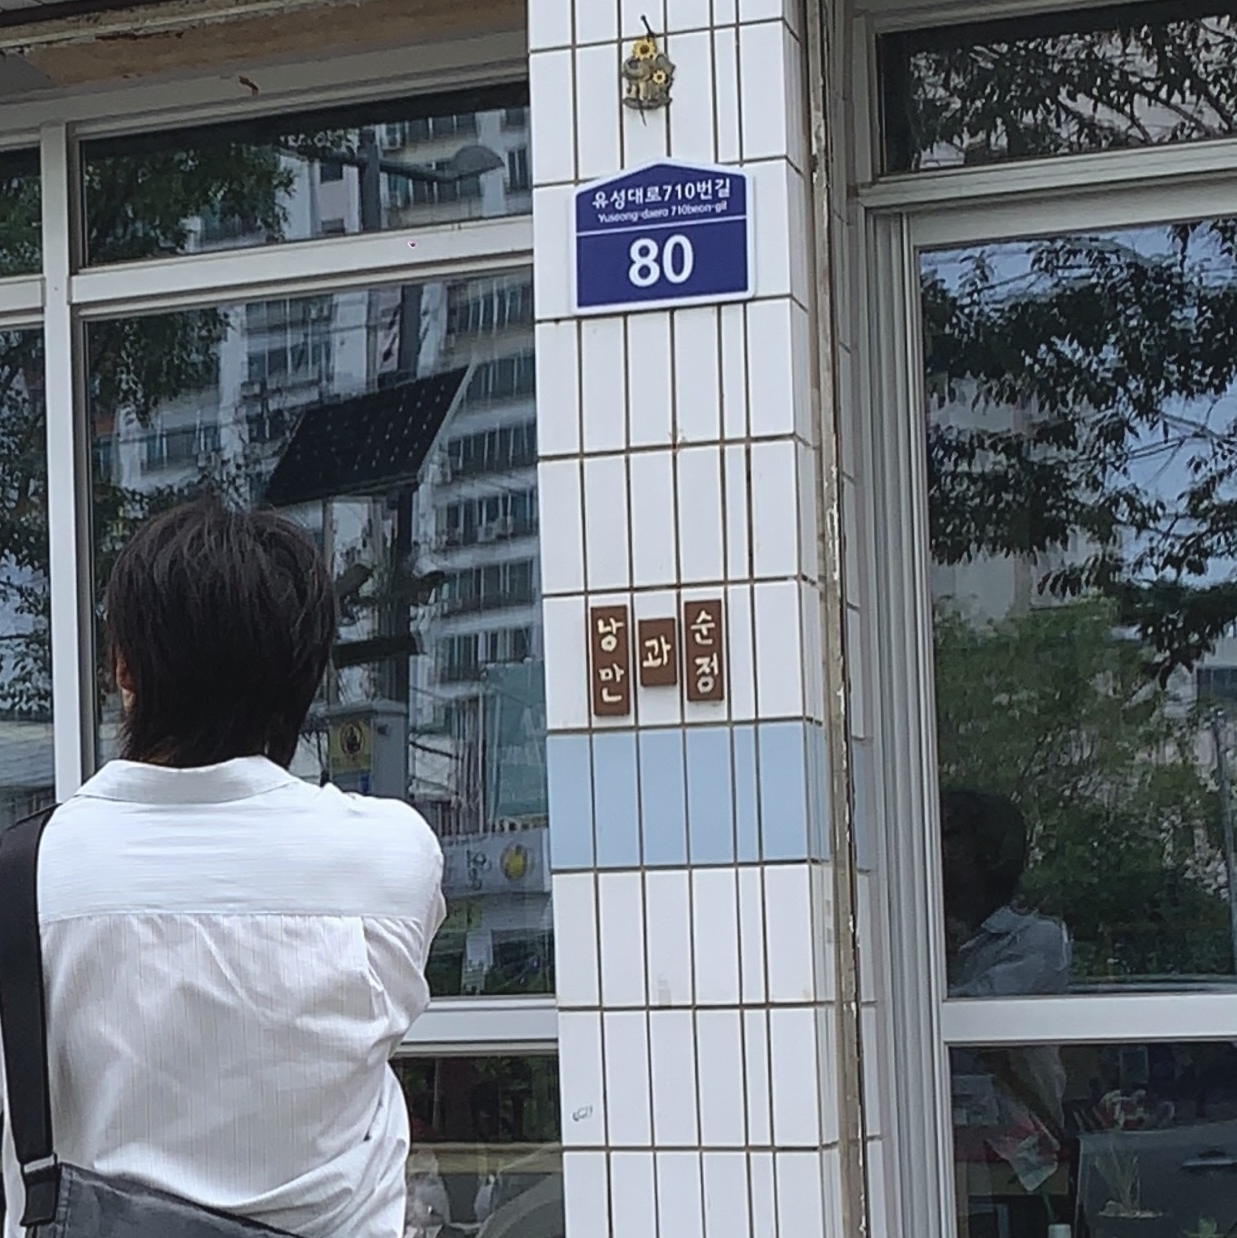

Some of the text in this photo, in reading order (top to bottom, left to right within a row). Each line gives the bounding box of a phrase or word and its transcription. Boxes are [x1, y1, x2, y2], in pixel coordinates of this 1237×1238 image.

[592, 178, 730, 209] 유성대로710번길
[598, 201, 728, 223] Yuseong-daero 710beon-gil
[628, 233, 694, 288] 80
[598, 610, 719, 702] 낭만 과 순정
